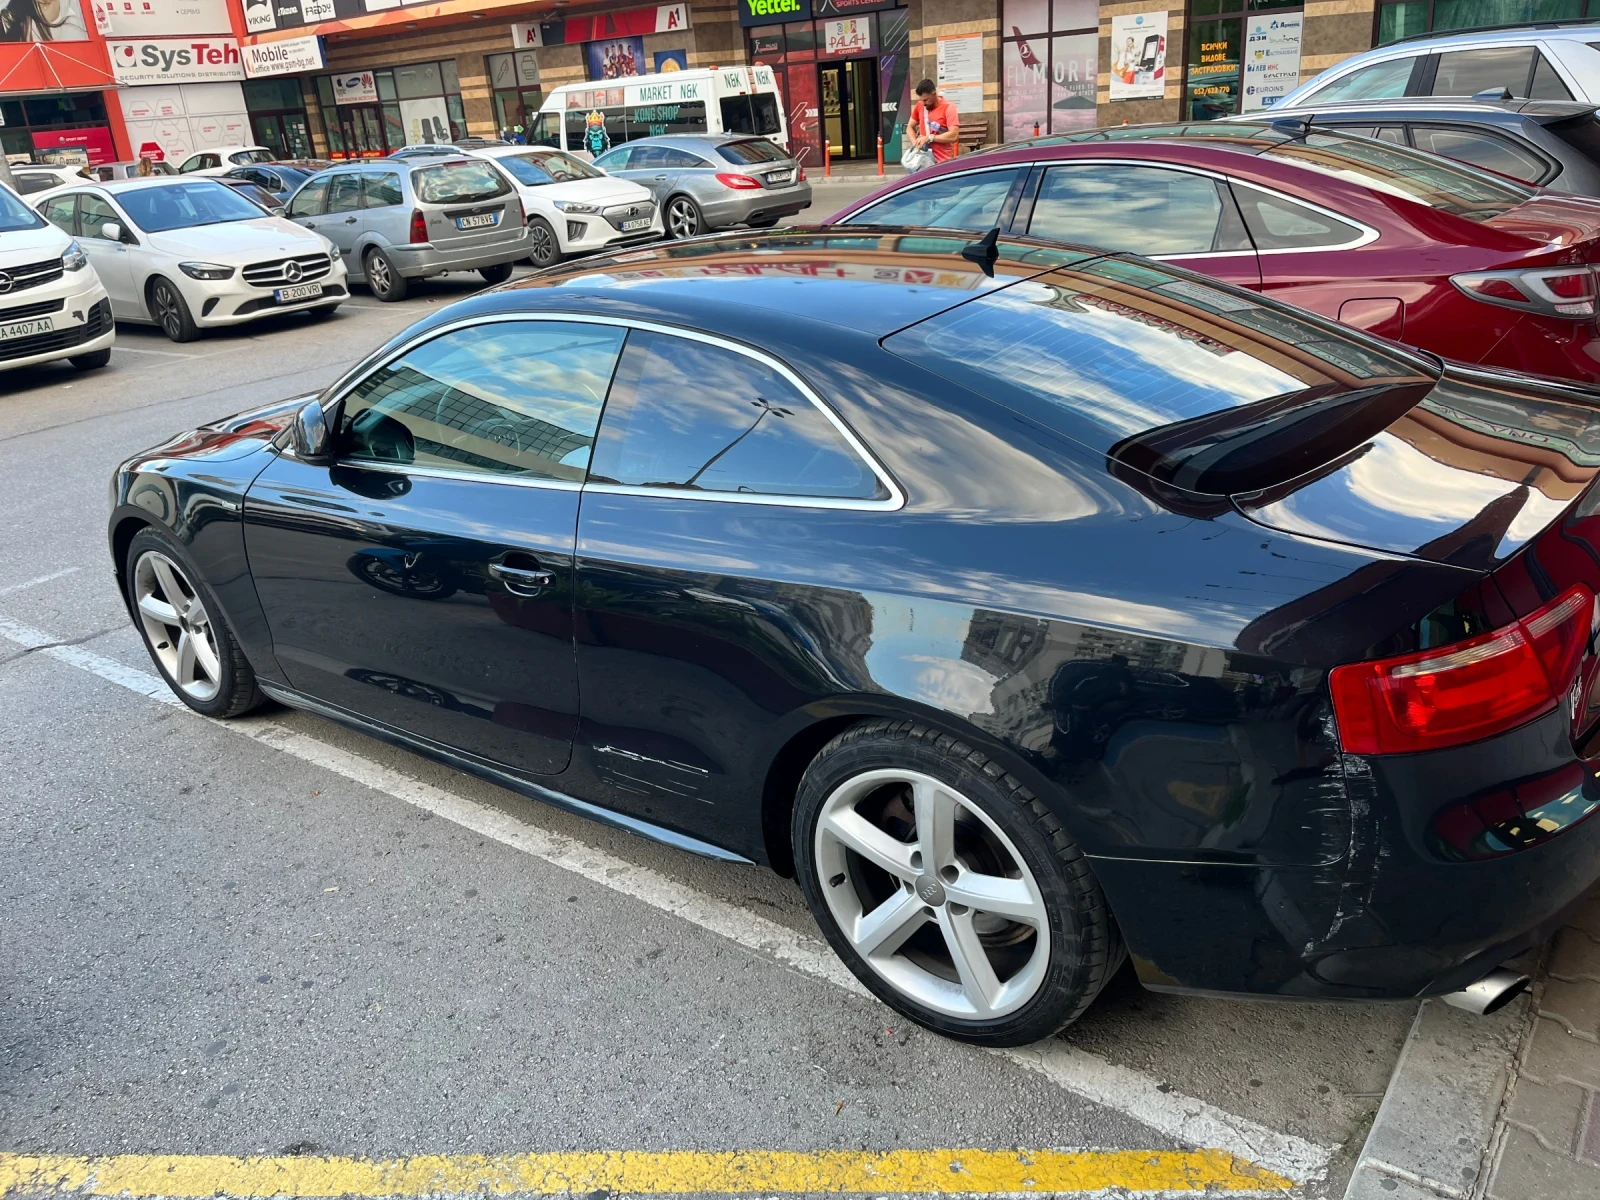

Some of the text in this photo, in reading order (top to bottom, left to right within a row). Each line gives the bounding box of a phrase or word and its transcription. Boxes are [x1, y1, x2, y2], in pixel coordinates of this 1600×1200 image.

[248, 14, 271, 25] VIKING
[667, 7, 680, 30] A1
[526, 27, 536, 43] A1
[1201, 41, 1228, 51] ВСИЧКИ
[141, 43, 239, 72] SysTeh
[251, 45, 289, 64] Mobile
[1201, 53, 1227, 63] ВИДОВЕ
[255, 56, 316, 74] office www.gsm-bg.net
[1191, 64, 1236, 75] ЗАСТРАХОВКИ
[1256, 64, 1266, 72] ЛЕВ
[120, 70, 241, 81] SECURITY SOLUTIONS DISTRIBUTOR
[724, 72, 742, 88] N&K
[755, 70, 771, 85] N&K
[1007, 59, 1095, 87] FLY MORE
[640, 83, 698, 102] MARKET N&K
[1256, 86, 1284, 94] EUROINS
[634, 105, 679, 122] KONG SHOP
[649, 124, 666, 136] N&K
[462, 214, 494, 227] CN 578VE
[282, 284, 320, 299] B 200 VRI
[10, 322, 34, 336] 4407
[38, 320, 51, 332] AA
